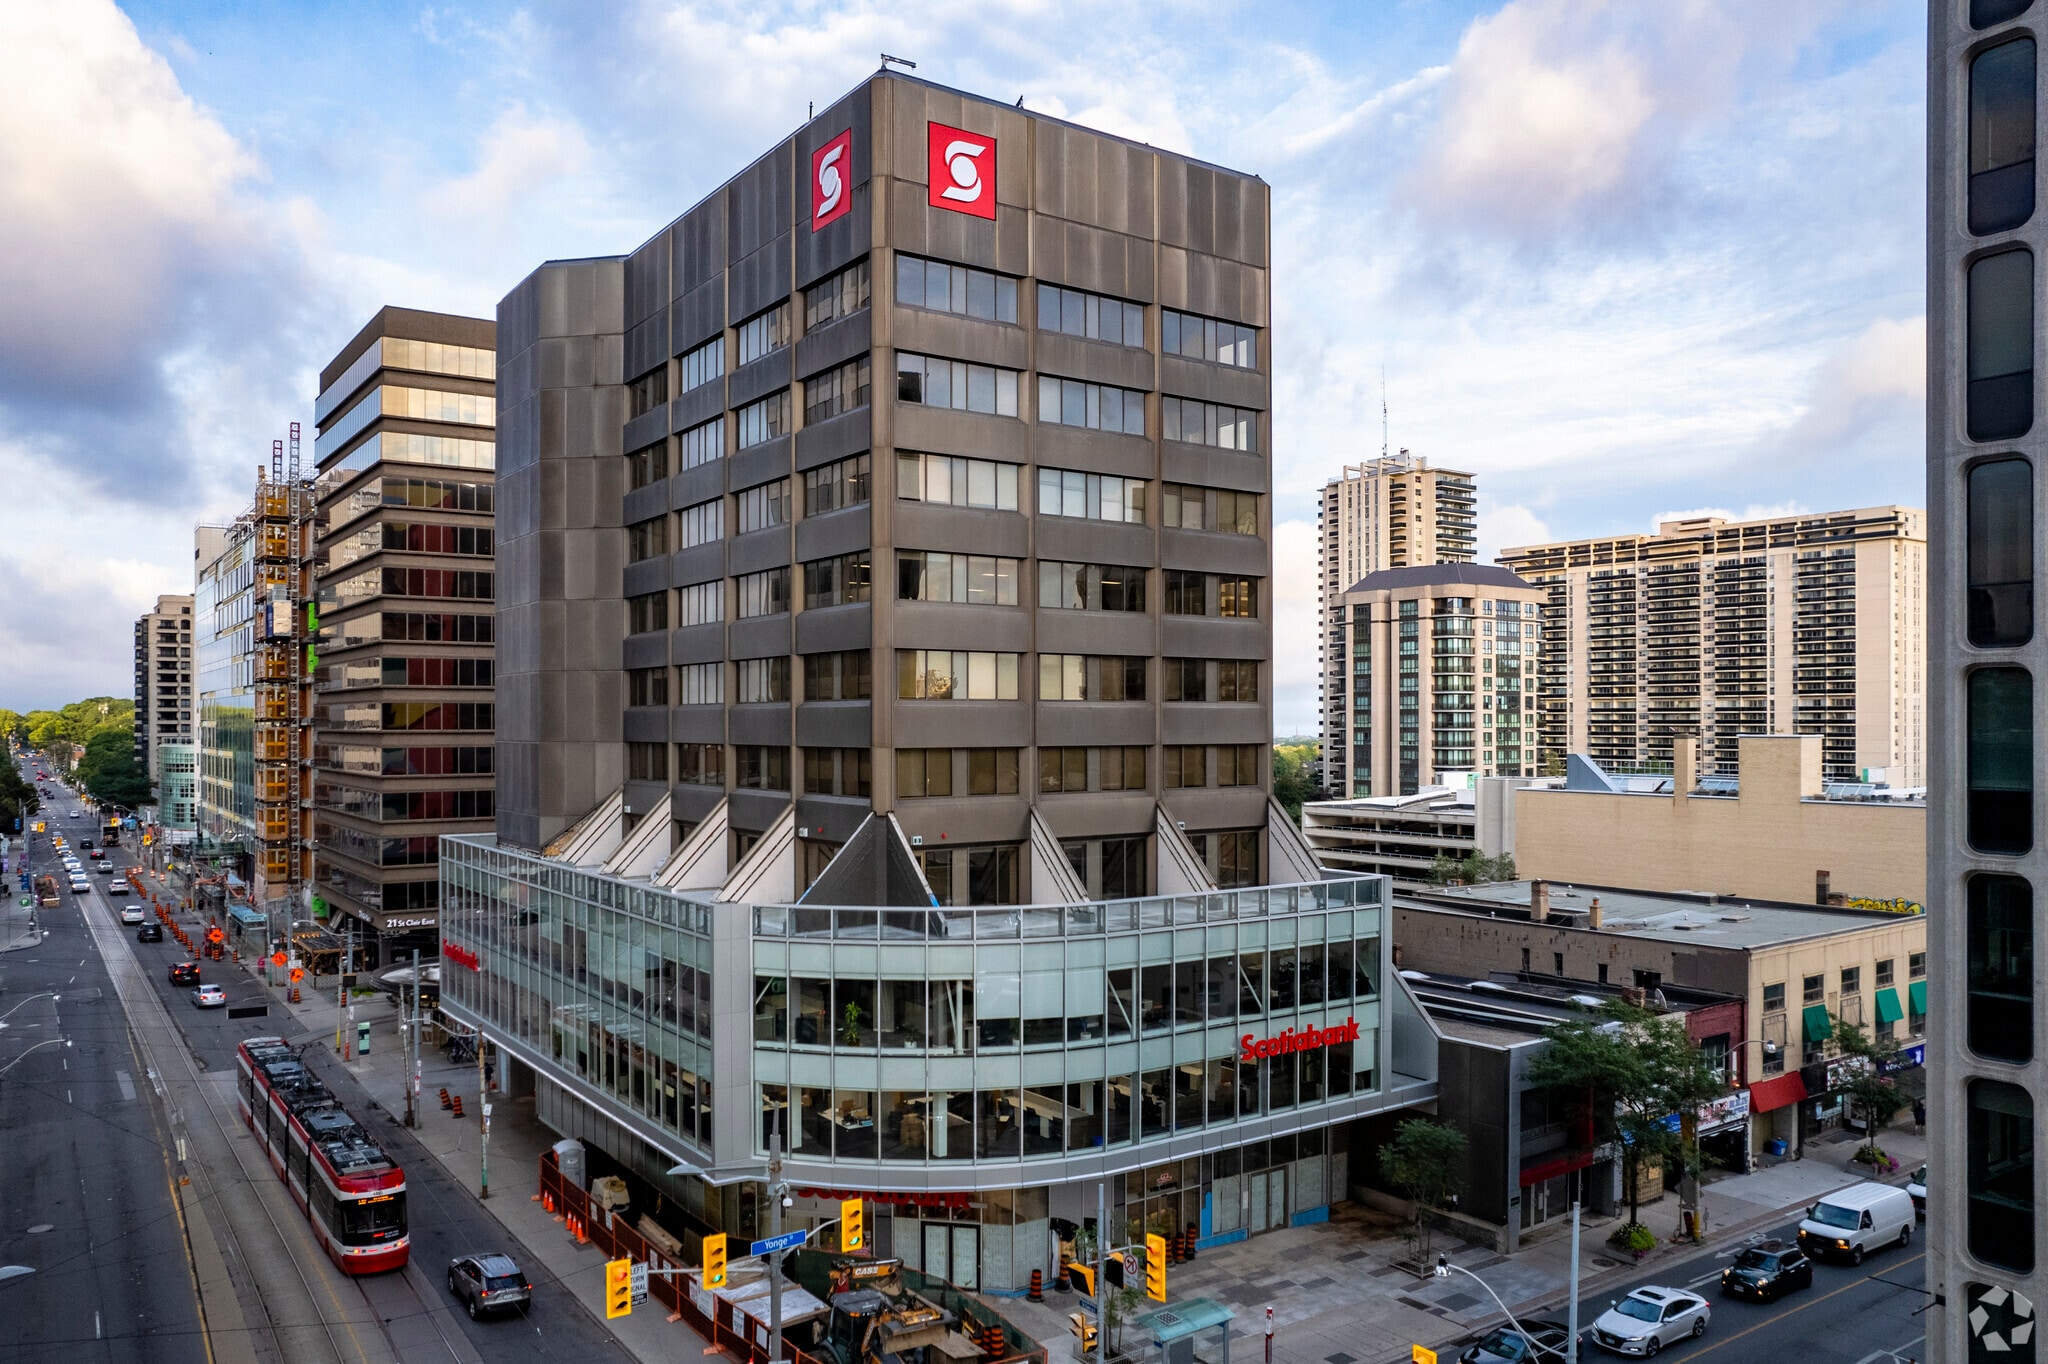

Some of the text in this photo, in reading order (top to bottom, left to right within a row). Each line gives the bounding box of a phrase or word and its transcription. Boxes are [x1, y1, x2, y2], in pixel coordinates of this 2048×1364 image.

[386, 919, 397, 928] 21
[1241, 1016, 1360, 1061] Scotiabank
[765, 1237, 788, 1249] Yonge
